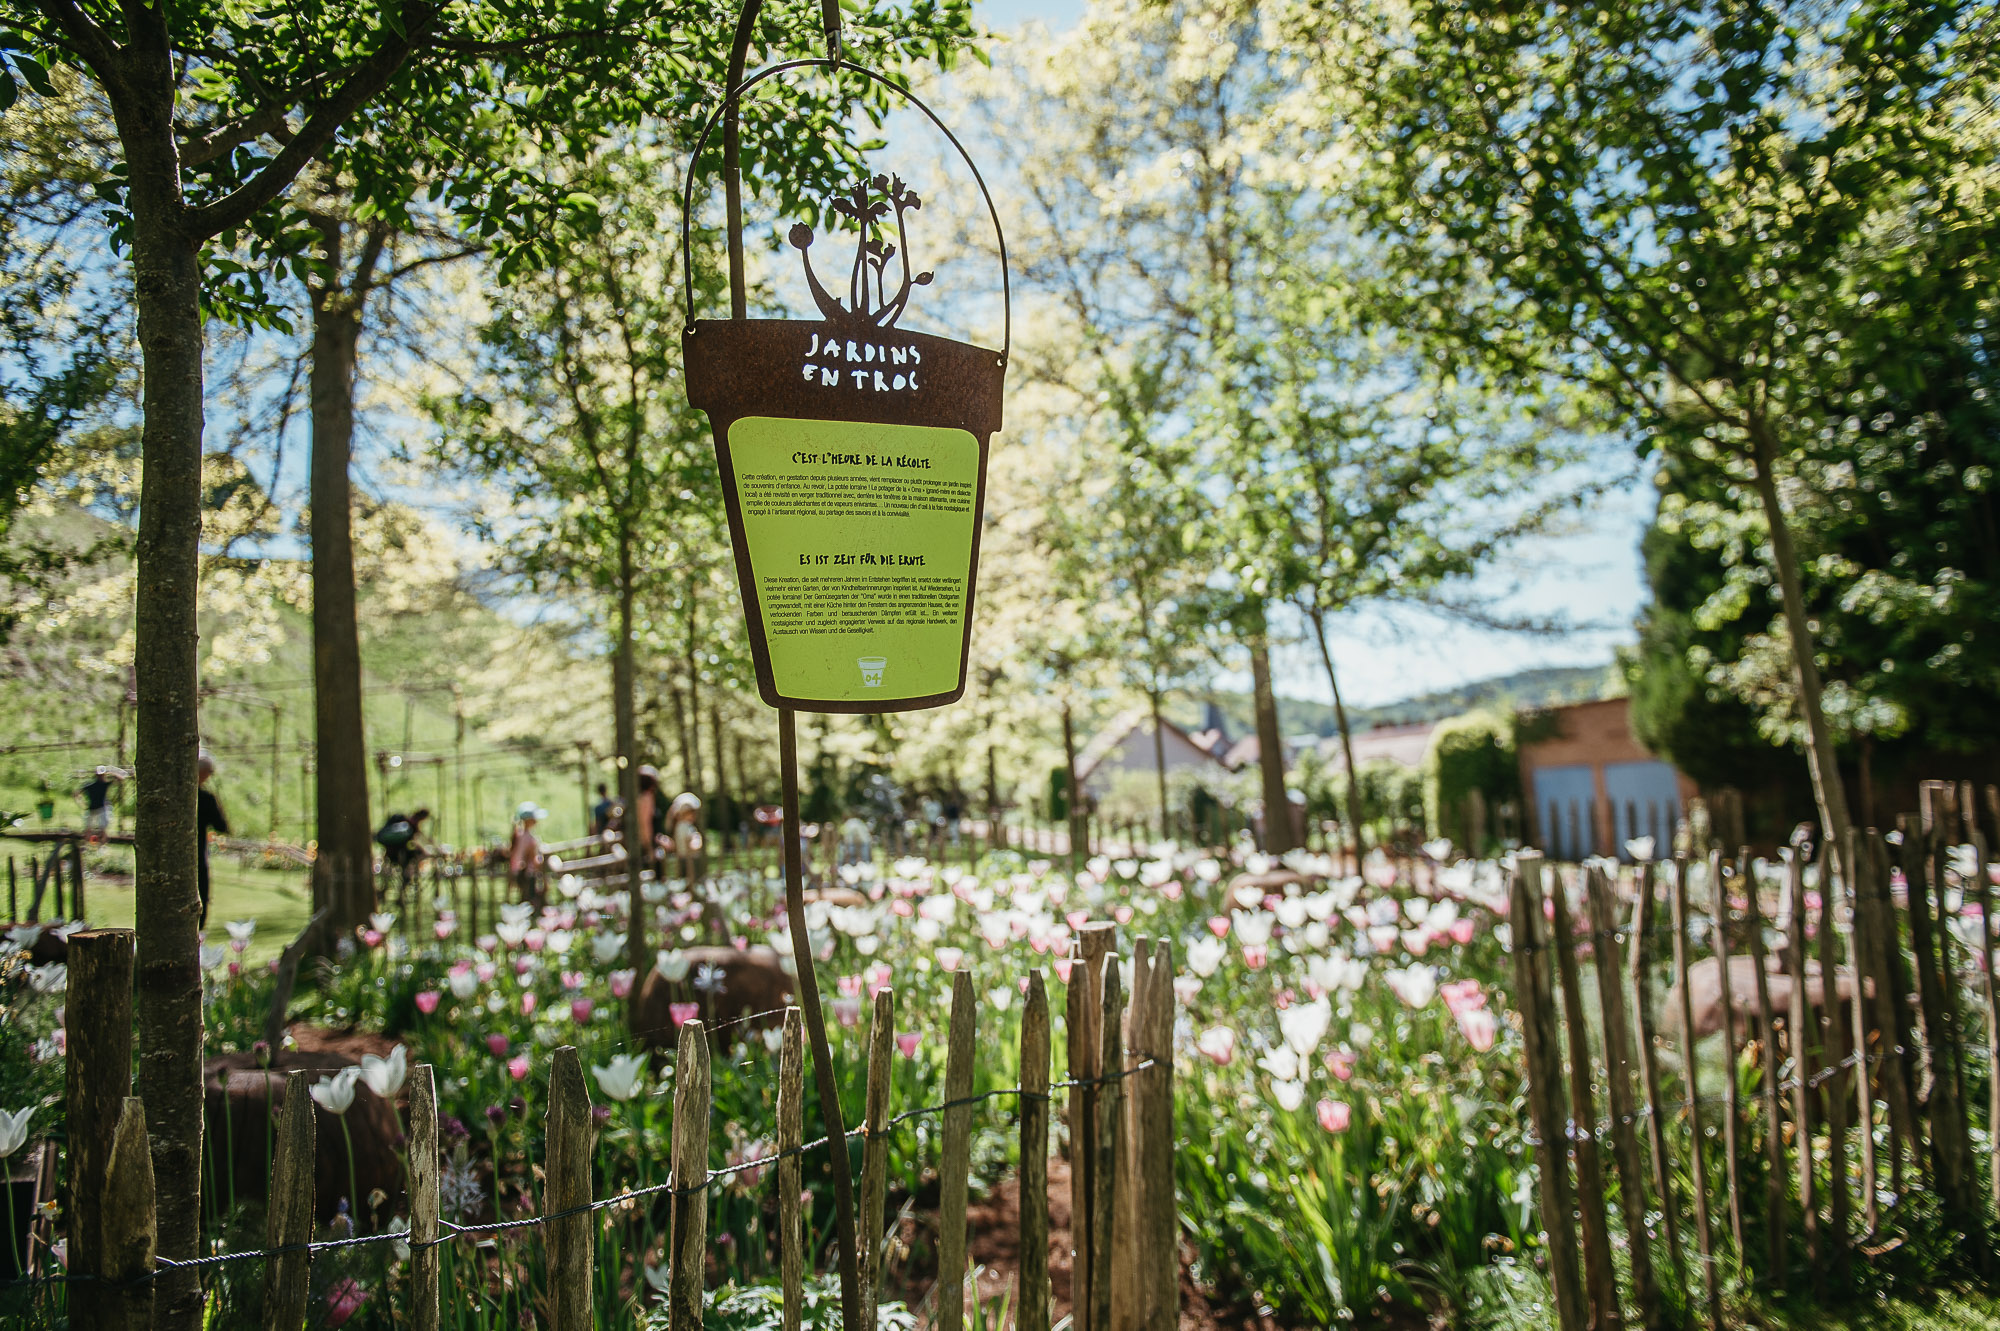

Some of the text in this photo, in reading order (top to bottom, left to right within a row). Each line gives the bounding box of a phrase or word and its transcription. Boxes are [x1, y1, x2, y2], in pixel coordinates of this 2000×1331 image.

[804, 333, 921, 365] JARDINS
[802, 364, 919, 392] EN TROC
[792, 452, 931, 469] C'EST L'HEURE DE LA RÉCOLTE
[787, 474, 809, 482] gestation
[810, 474, 826, 482] depuis
[828, 474, 849, 483] plusieurs
[850, 475, 868, 483] années,
[881, 476, 903, 485] remplacer
[948, 480, 959, 489] jardin
[835, 483, 849, 491] potée
[878, 484, 894, 493] potager
[746, 500, 763, 508] emplie
[748, 508, 766, 516] engagé
[826, 508, 844, 517] partage
[800, 553, 926, 566] ES IST ZEIT FÜR DIE ERNTE
[892, 576, 910, 585] begriffen
[841, 585, 892, 593] Kindheitserinnerungen
[893, 585, 911, 593] inspiriert
[767, 594, 781, 602] potée
[814, 593, 850, 602] Gemüsegarten
[898, 601, 927, 610] angrenzenden
[881, 610, 902, 618] Dämpfen
[772, 619, 803, 628] nostalgischer
[818, 619, 837, 627] zugleich
[838, 618, 866, 627] engagierter
[906, 618, 925, 626] regionale
[866, 673, 881, 684] 04
